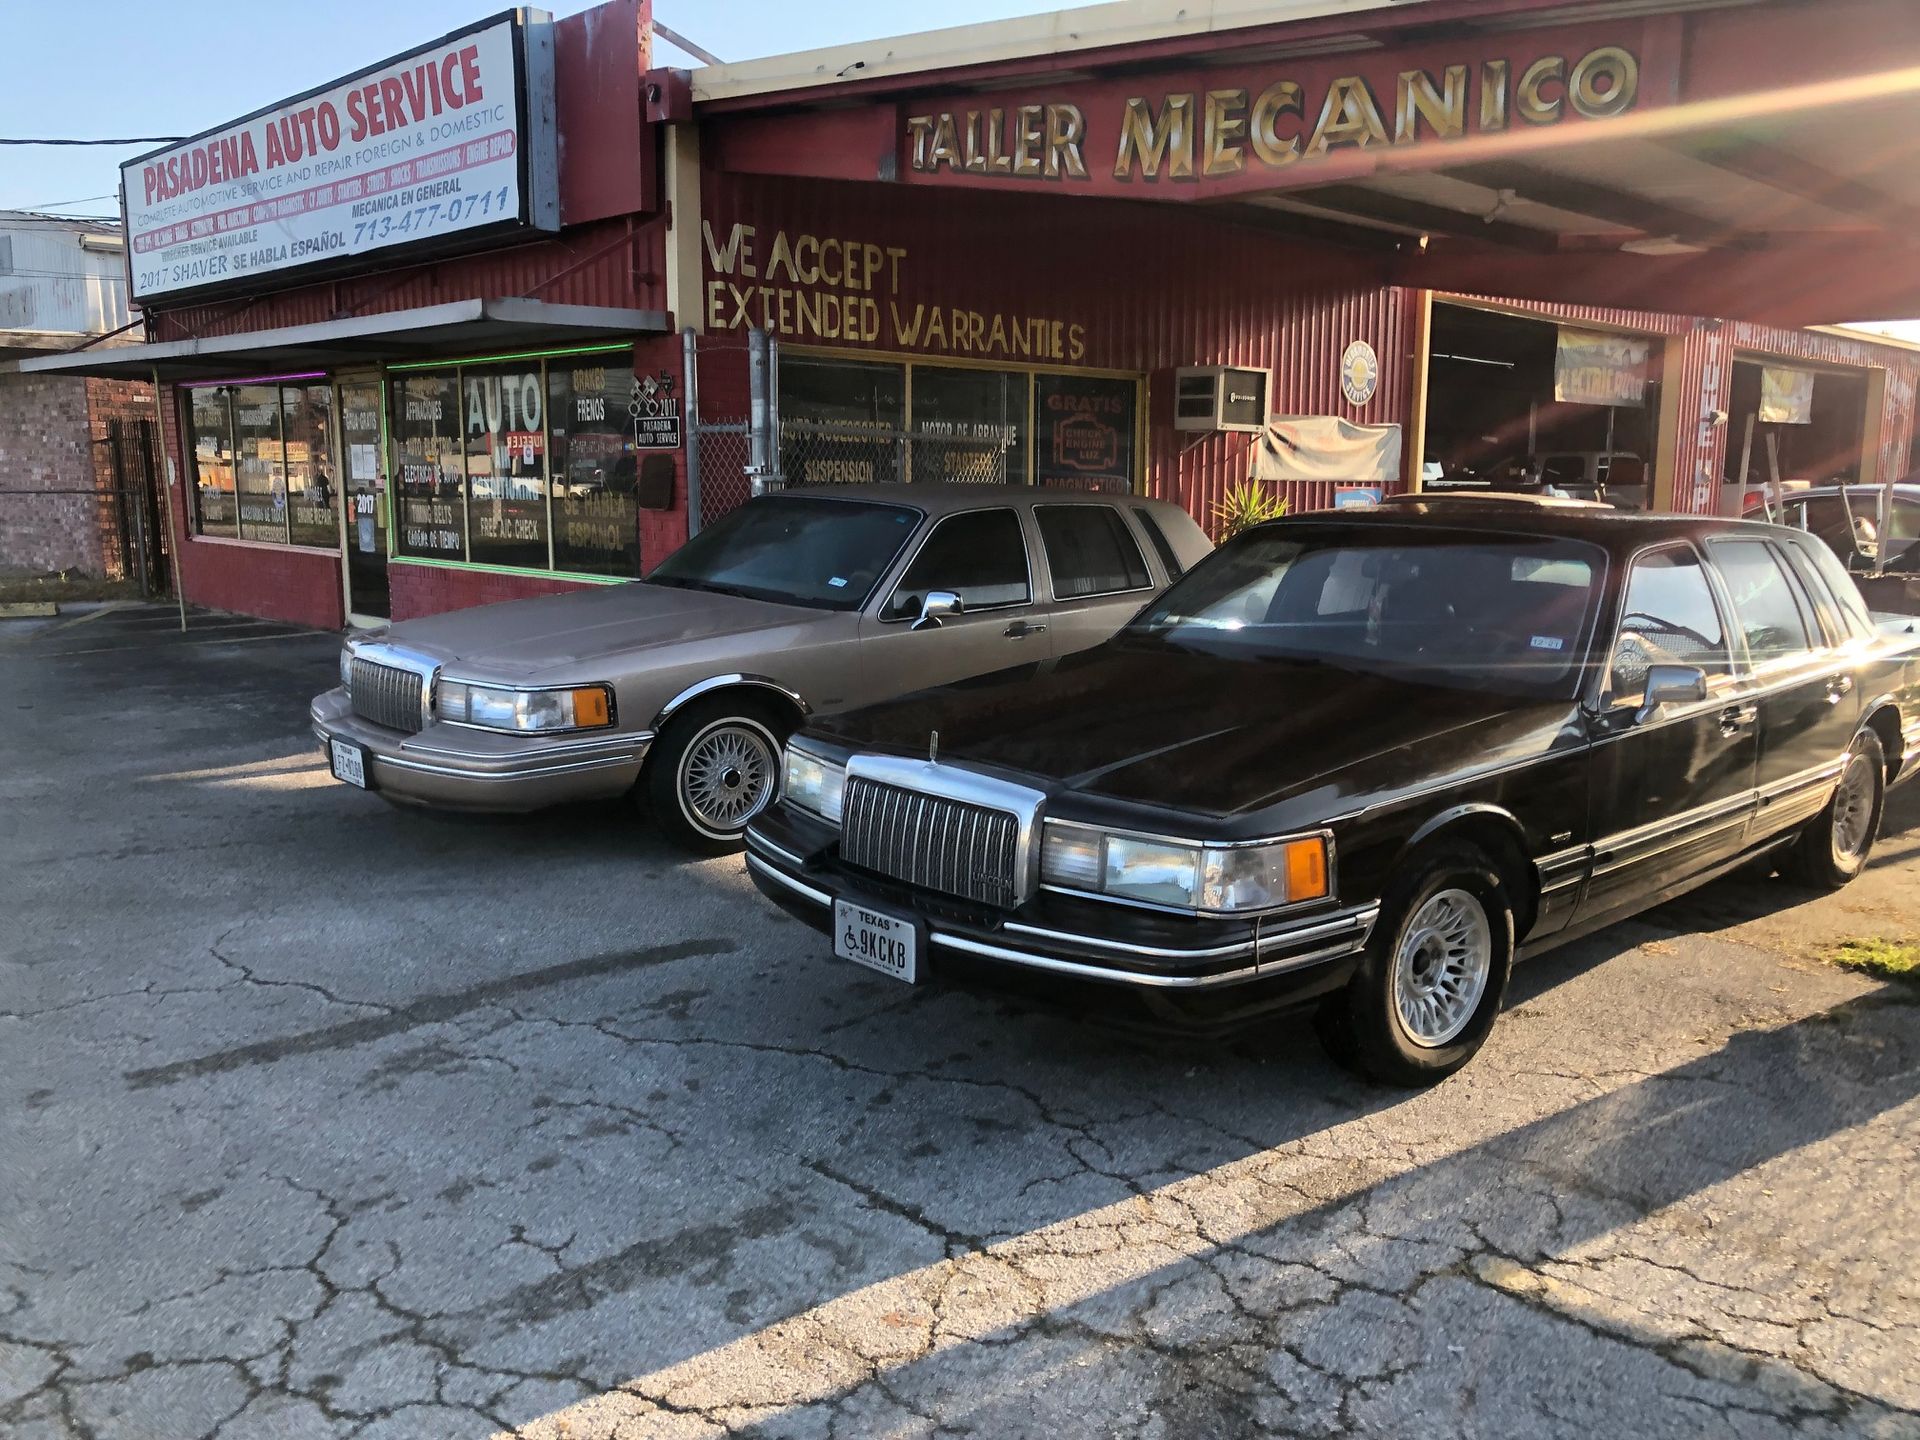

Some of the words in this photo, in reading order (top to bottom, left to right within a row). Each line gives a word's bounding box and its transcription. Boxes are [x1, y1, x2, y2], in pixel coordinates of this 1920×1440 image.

[907, 105, 1088, 178] TALLER
[1112, 47, 1640, 178] MECANICO
[144, 131, 260, 206] PASADENA
[266, 101, 340, 170] AUTO
[347, 45, 483, 142] SERVICE
[138, 205, 176, 227] COMPLETE
[177, 188, 237, 214] AUTOMOTIVE
[241, 175, 282, 197] SERVICE
[287, 167, 311, 184] AND
[315, 155, 352, 176] REPAIR
[356, 136, 411, 165] FOREIGN
[416, 132, 424, 146] &
[431, 105, 504, 141] DOMESTIC
[352, 194, 398, 218] MECANICA
[401, 190, 414, 206] EN
[416, 177, 461, 201] GENERAL
[354, 186, 508, 244] 713-477-0711
[191, 238, 217, 256] SERVICE
[218, 229, 258, 250] AVAILABLE
[233, 254, 247, 270] SE
[251, 244, 287, 267] HABLA
[291, 230, 346, 257] ESPAÑOL
[703, 219, 757, 278] WE
[765, 230, 907, 295] ACCEPT
[140, 268, 168, 289] 2017
[173, 254, 227, 282] SHAVER
[708, 280, 879, 341] EXTENDED
[891, 302, 1084, 360] WARRANTIES
[468, 373, 541, 433] AUTO
[1047, 394, 1121, 413] GRATIS
[1346, 382, 1371, 402] SERVICE
[577, 398, 605, 421] FRENOS
[661, 398, 676, 416] 2017
[639, 432, 654, 443] AUTO
[656, 432, 677, 443] SERVICE
[643, 420, 671, 431] PASADENA
[972, 424, 1017, 446] ARRANUE
[804, 460, 873, 482] SUSPENSION
[357, 493, 374, 513] 2017
[433, 505, 452, 525] BELTS
[584, 492, 626, 518] HABLA
[439, 531, 460, 550] TIEMPO
[480, 517, 497, 538] FREE
[500, 518, 512, 539] A/C
[513, 519, 539, 541] CHECK
[972, 871, 1013, 889] LINCOLN
[859, 911, 890, 930] TEXAS
[860, 929, 905, 969] 9KCKB
